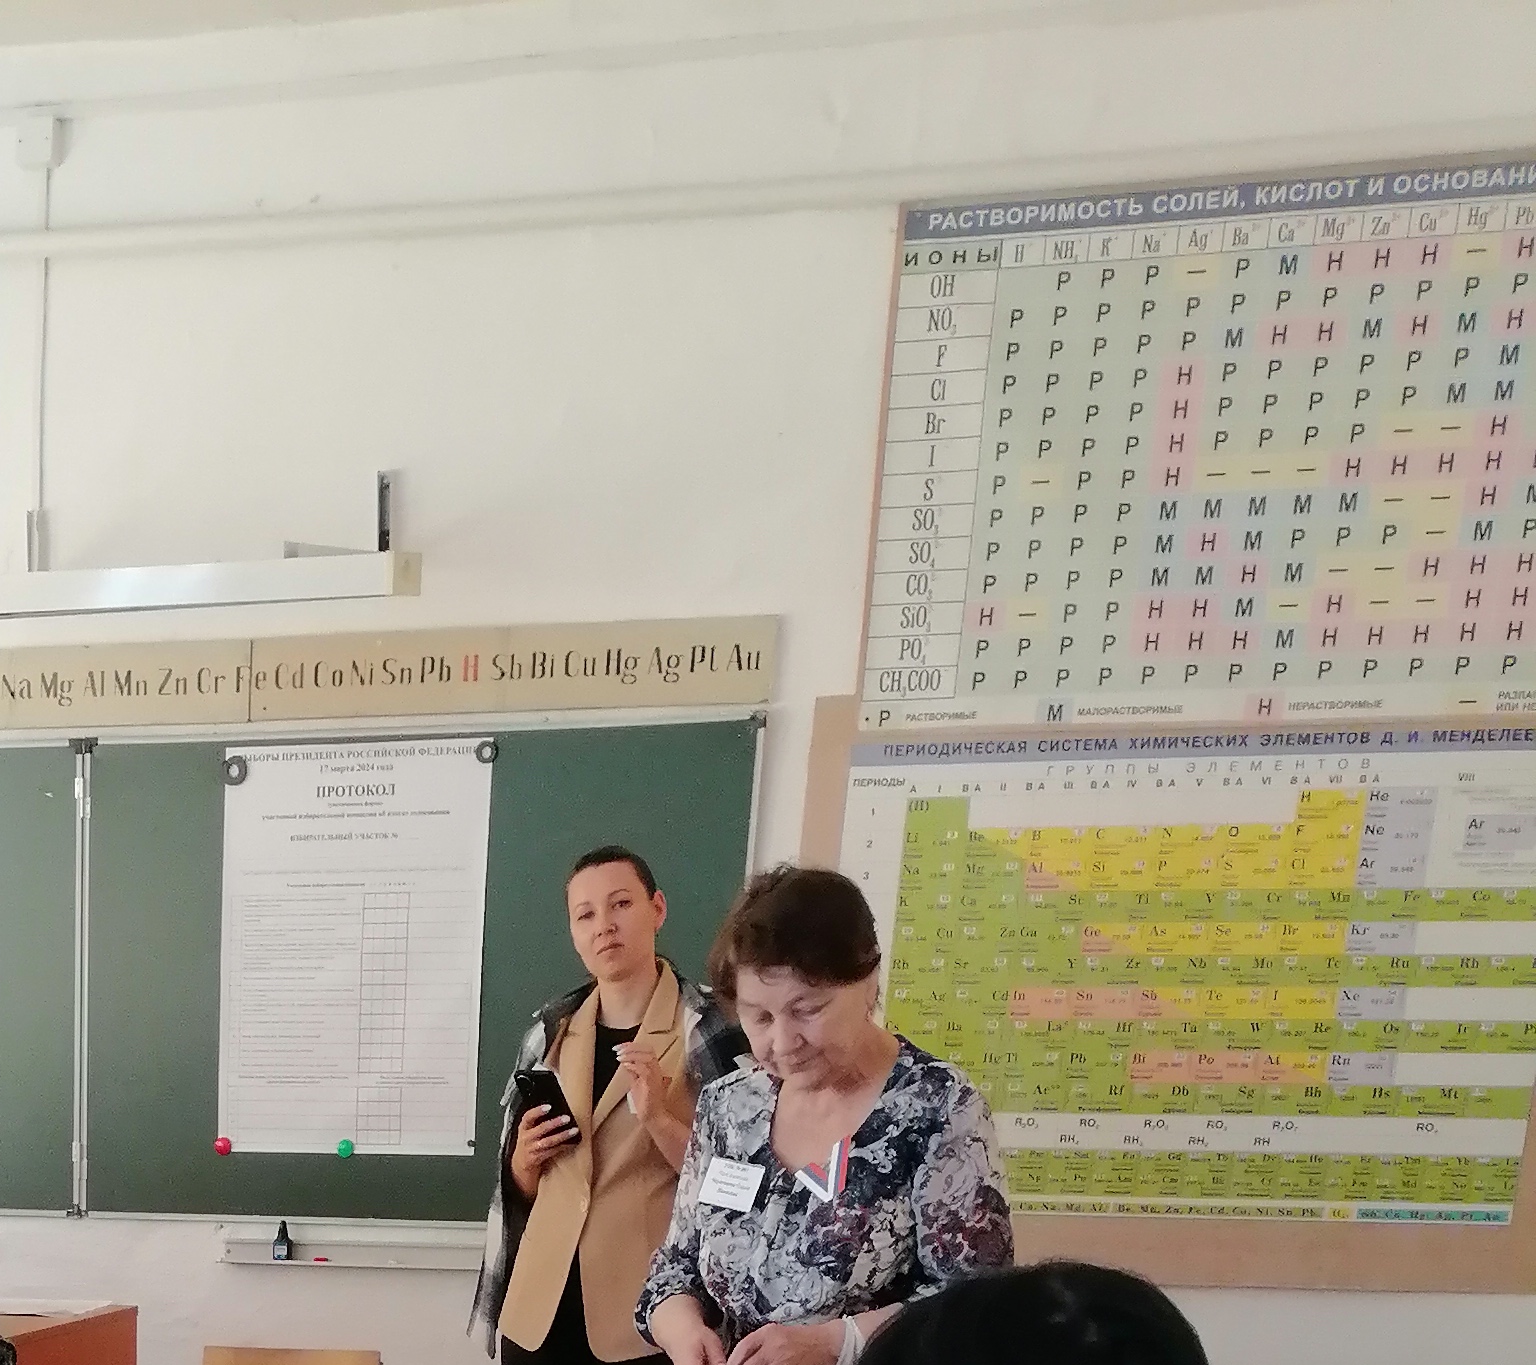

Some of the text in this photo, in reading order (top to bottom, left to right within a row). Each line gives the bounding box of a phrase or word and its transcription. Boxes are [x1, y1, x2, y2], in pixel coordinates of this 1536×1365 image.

[928, 197, 1144, 231] РАСТВОРИМОСТЬ
[1152, 187, 1246, 214] СОЛЕЙ,
[1255, 179, 1361, 206] КИСЛОТ
[1367, 177, 1384, 196] И
[925, 412, 946, 434] Br
[2, 674, 33, 700] Na
[40, 671, 74, 707] Mg
[83, 670, 105, 697] Al
[114, 669, 148, 697] Mn
[158, 667, 187, 696] Zn
[197, 667, 226, 695] Cr
[235, 664, 267, 694] Fe
[274, 662, 304, 690] Cd
[314, 660, 343, 688] Co
[350, 660, 374, 686] Ni
[382, 657, 412, 685] Sn
[420, 655, 451, 684] Pb
[462, 654, 479, 682] H
[491, 653, 522, 681] Sb
[531, 651, 555, 679] Bi
[564, 650, 597, 678] Cu
[604, 648, 641, 685] Hg
[648, 646, 684, 683] Ag
[689, 644, 718, 673] Pt
[726, 643, 760, 671] Au
[1288, 699, 1384, 711] НЕРАСТВОРИМЫЕ
[905, 711, 978, 722] РАСТВОРИМЫЕ
[418, 746, 479, 758] ФЕДЕРАЦИ
[884, 740, 1027, 758] ПЕРИОДИЧЕСКАЯ
[1037, 738, 1118, 753] СИСТЕМА
[1128, 734, 1250, 751] ХИМИЧЕСКИХ
[1259, 732, 1371, 747] ЭЛЕМЕНТОВ
[1432, 728, 1534, 744] МЕНДЕЛЕЕ
[316, 783, 395, 799] ПРОТОКОЛ
